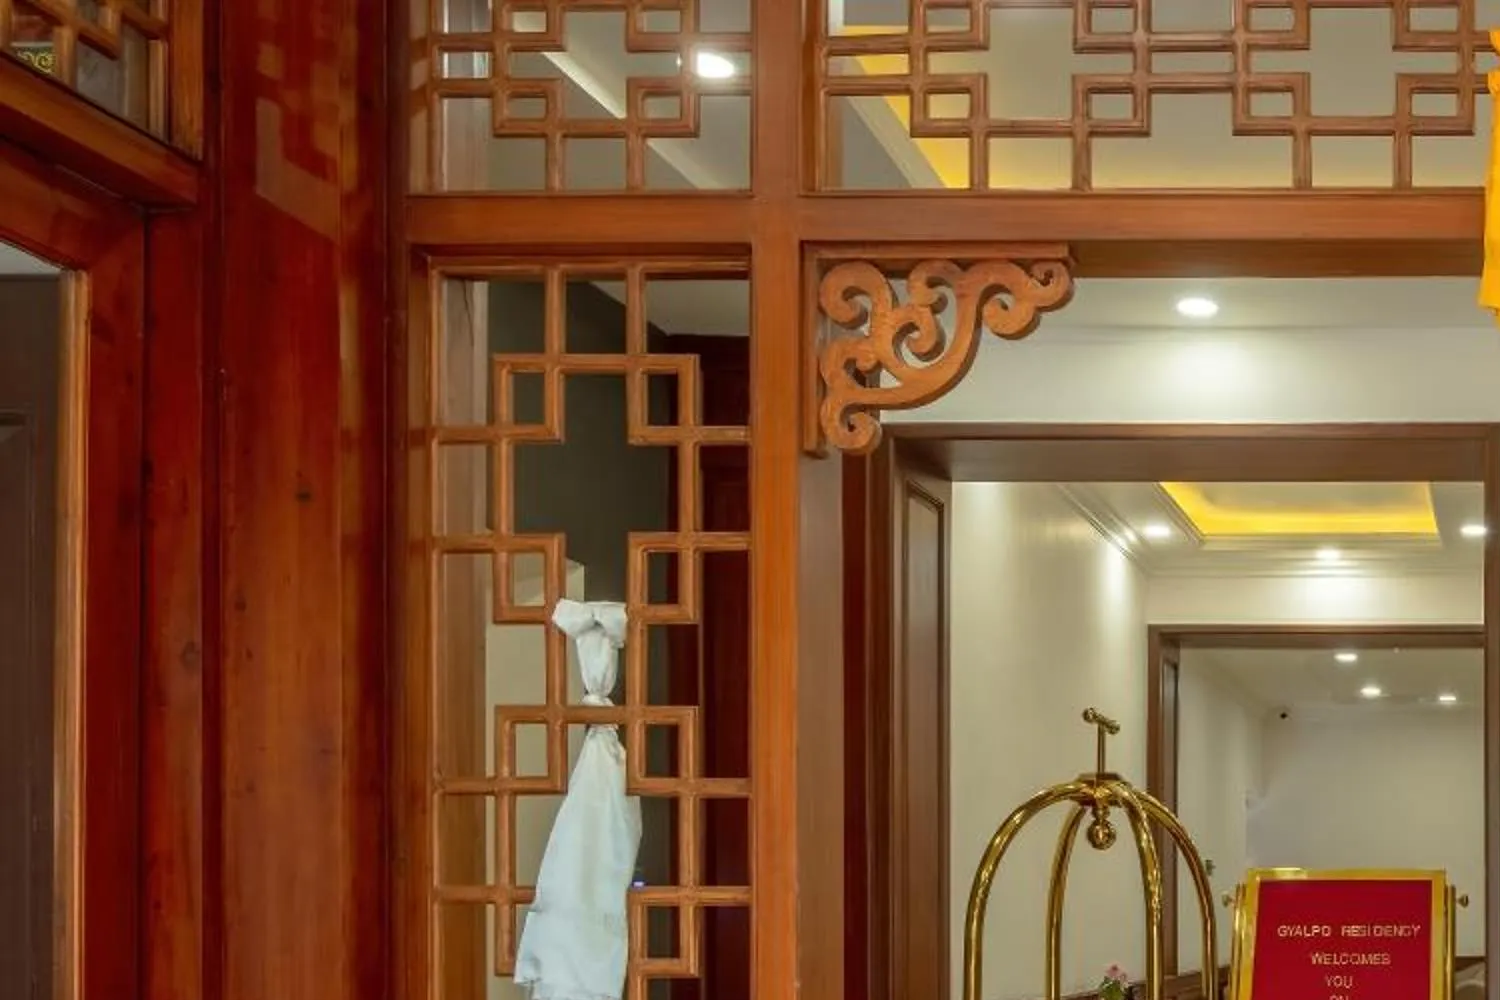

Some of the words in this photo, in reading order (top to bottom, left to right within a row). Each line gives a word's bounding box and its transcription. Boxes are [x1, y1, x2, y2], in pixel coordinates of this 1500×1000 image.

[1277, 924, 1332, 938] GYALPO
[1310, 951, 1391, 966] WELCOMES
[1325, 975, 1353, 989] YOU
